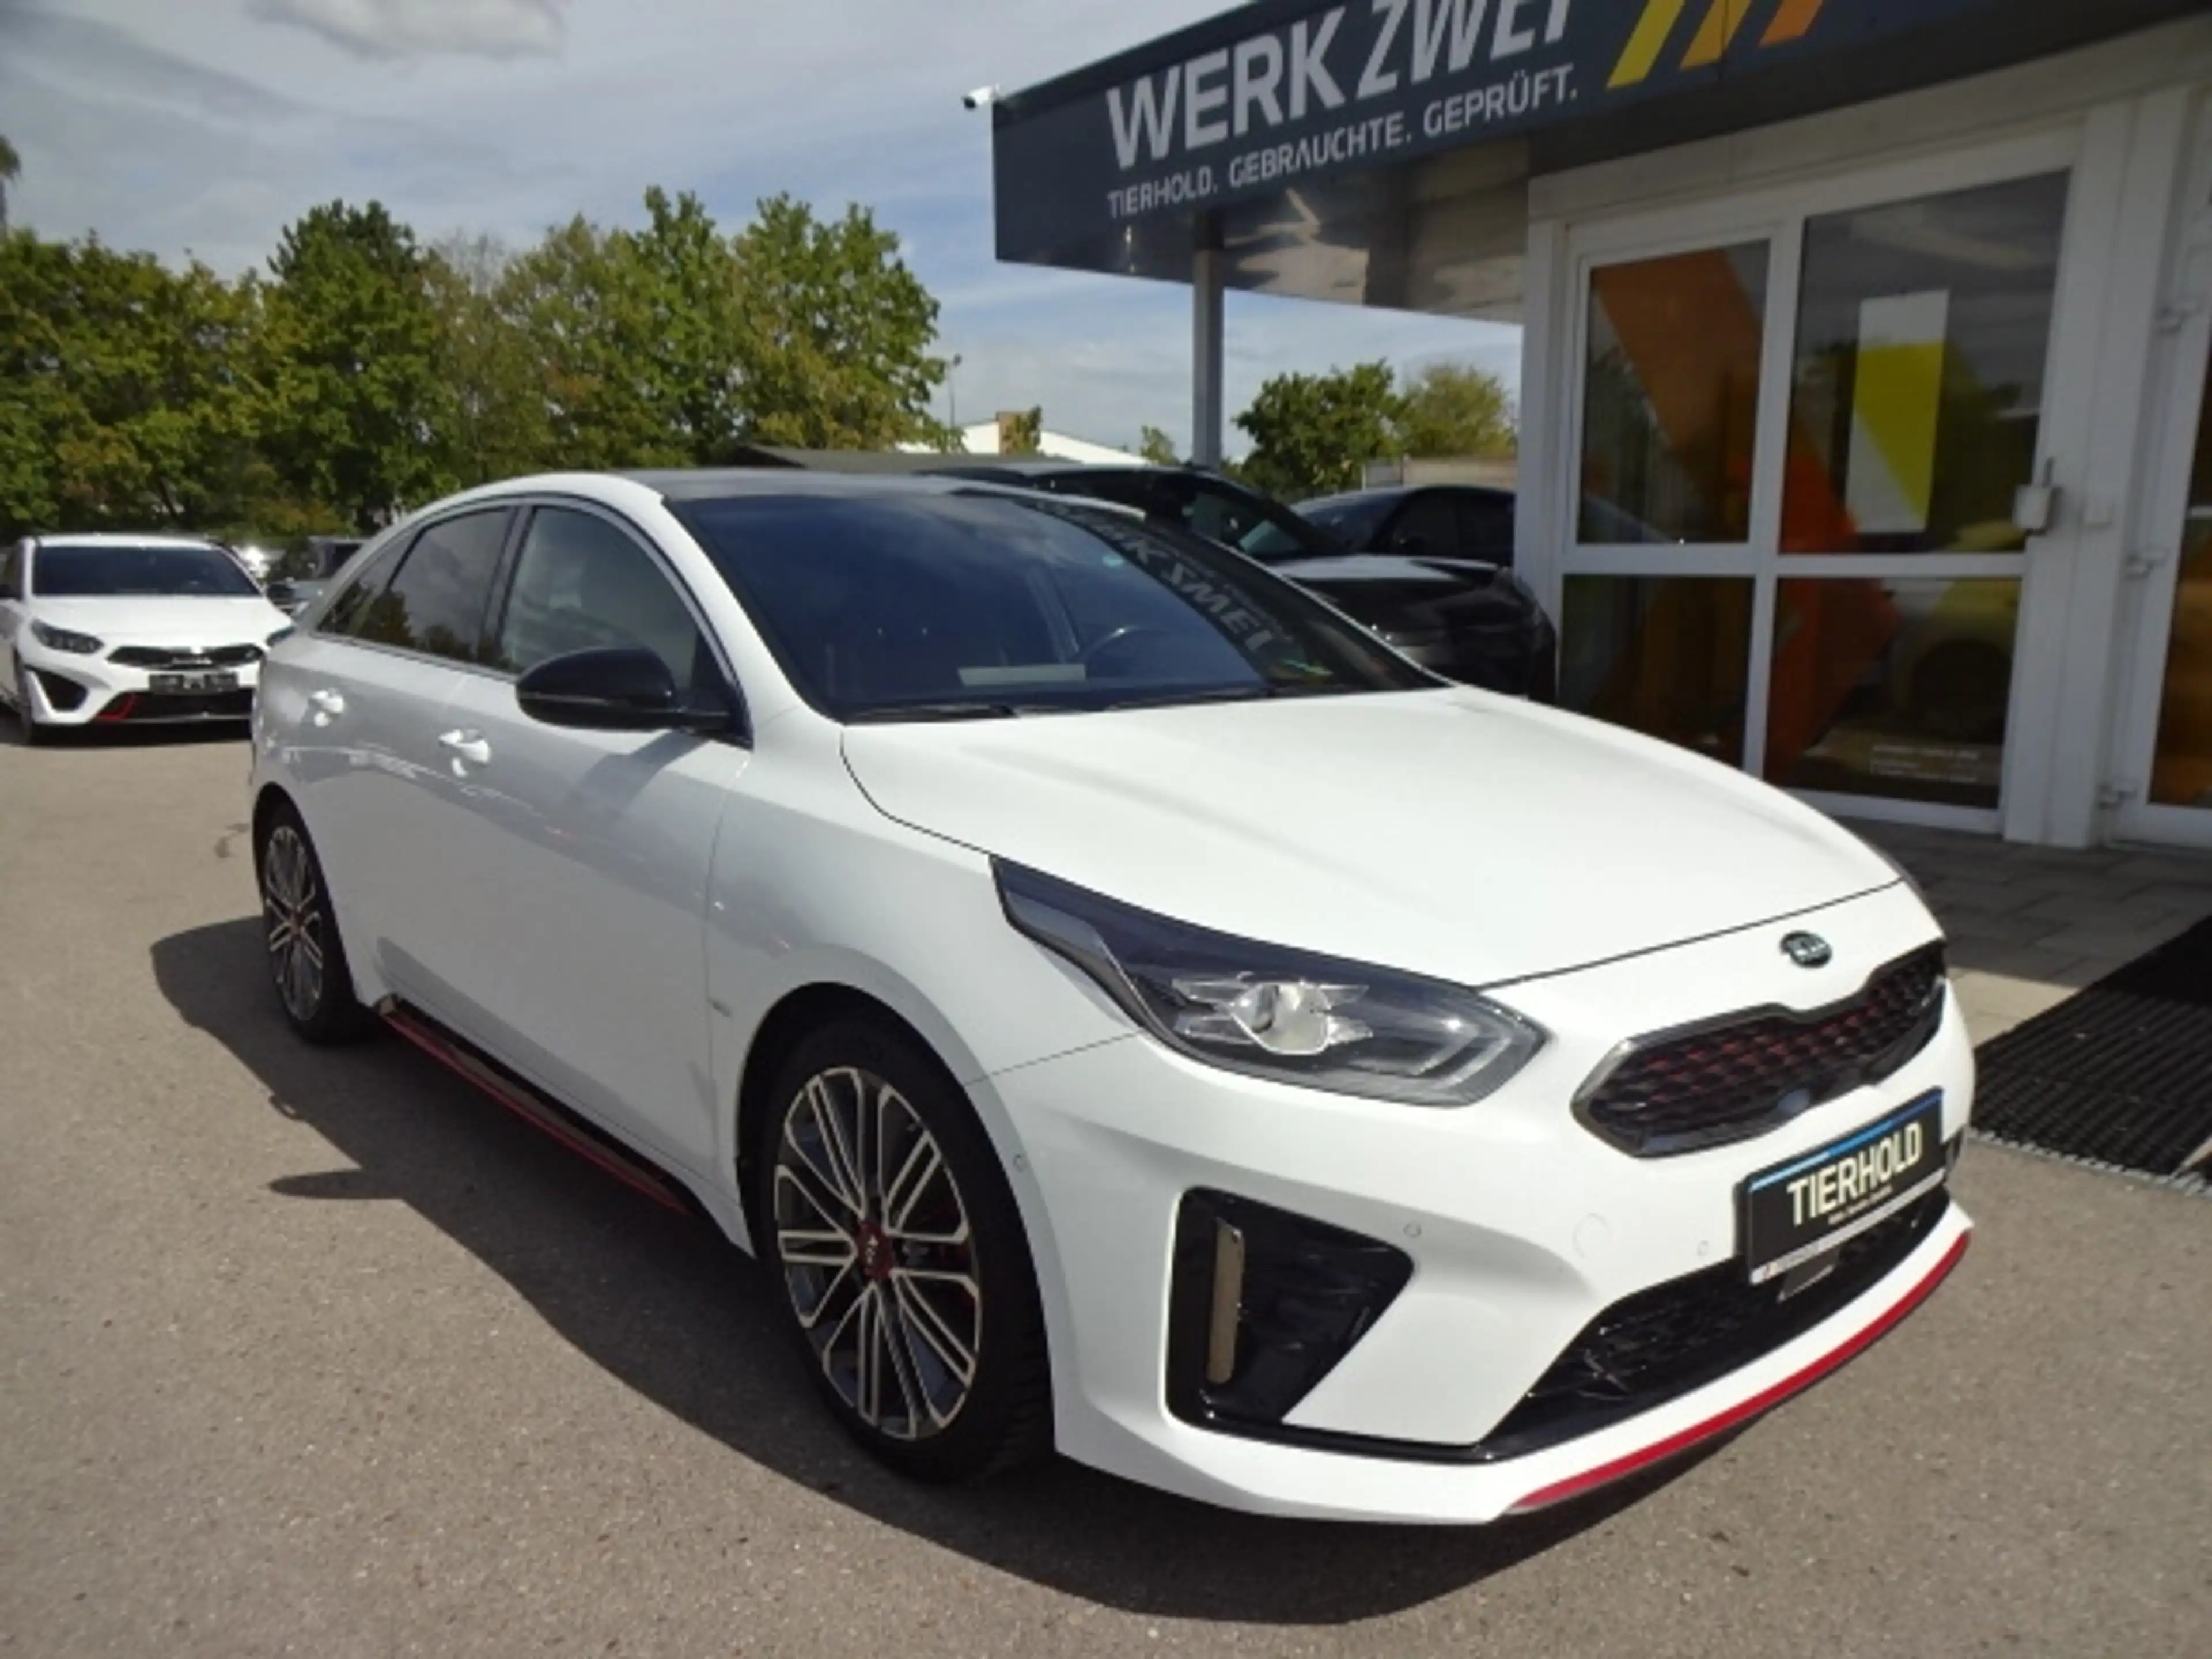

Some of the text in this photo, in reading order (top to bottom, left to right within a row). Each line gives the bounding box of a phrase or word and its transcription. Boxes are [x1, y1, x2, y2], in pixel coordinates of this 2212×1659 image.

[1105, 10, 1346, 171] WERK
[1107, 63, 1578, 218] TIERHOLD. GEBRAUCHTE. GEPRÜFT.
[1787, 1123, 1923, 1226] TIERHOLD
